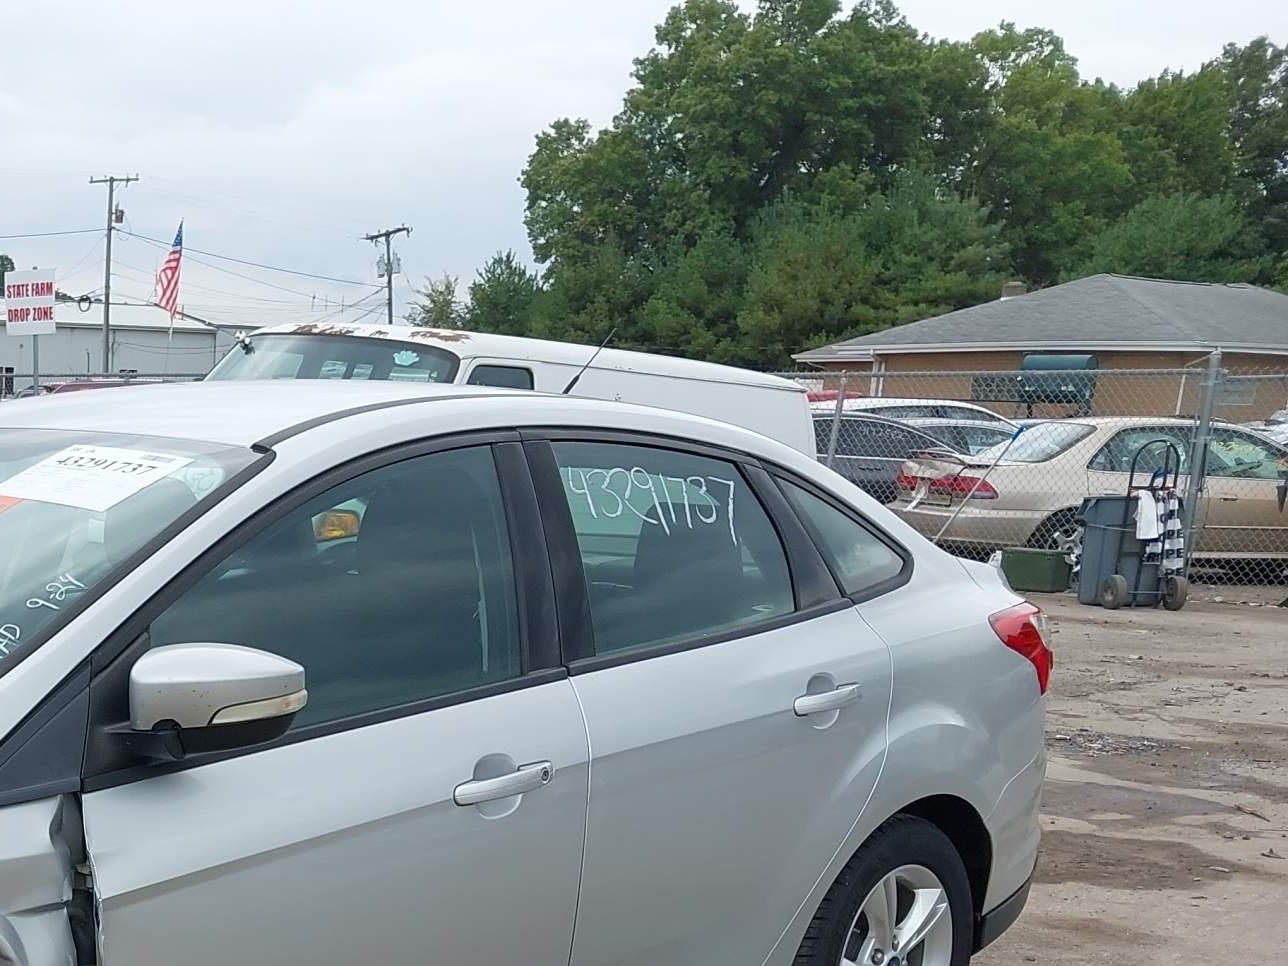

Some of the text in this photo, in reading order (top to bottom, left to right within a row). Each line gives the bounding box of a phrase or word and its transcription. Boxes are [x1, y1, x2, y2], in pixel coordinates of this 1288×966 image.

[7, 282, 53, 298] STATE FARM
[8, 307, 53, 322] DROP ZONE
[55, 456, 160, 475] 43291737
[568, 465, 738, 547] 43291737
